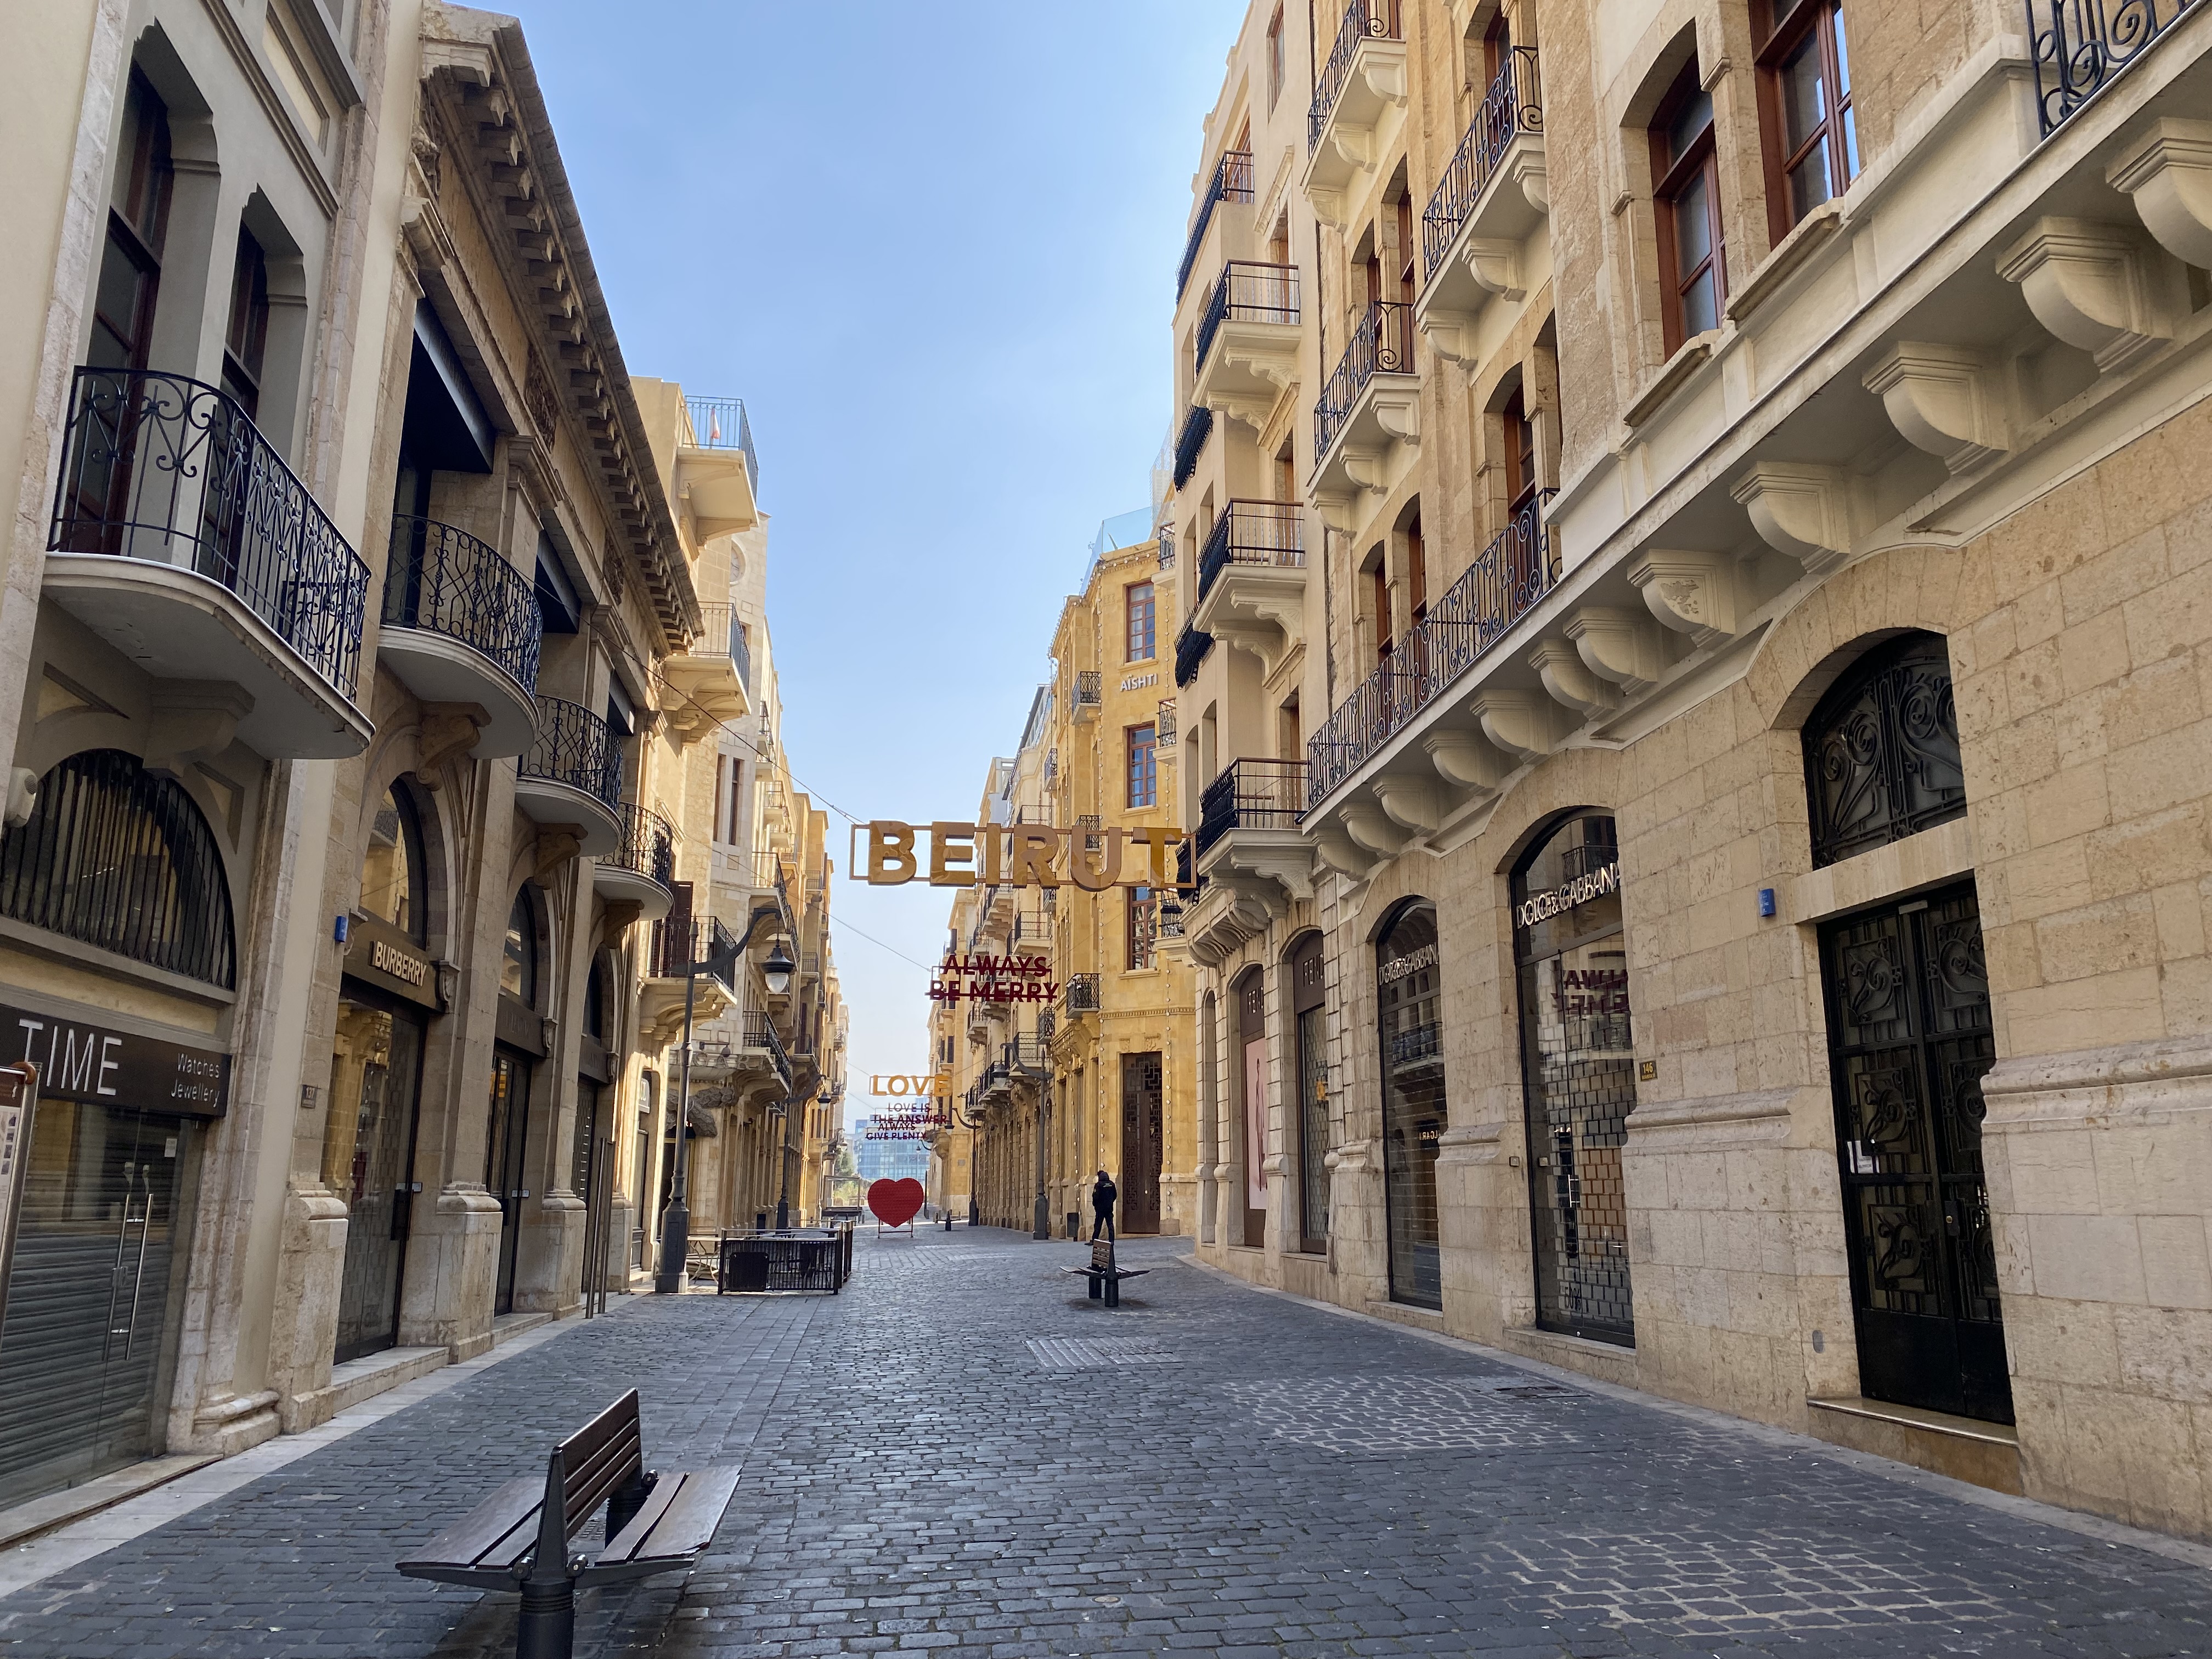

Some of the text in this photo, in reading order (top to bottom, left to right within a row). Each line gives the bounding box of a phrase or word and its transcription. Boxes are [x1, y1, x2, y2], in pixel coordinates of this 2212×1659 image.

[1120, 673, 1158, 692] AÏSHTI
[867, 820, 1182, 891] BEIRUT
[370, 941, 427, 987] BURBERRY
[944, 955, 1047, 977] ALWAYS
[1303, 953, 1324, 987] FEND
[1379, 942, 1439, 985] DOLCE&GABBAN
[930, 980, 1060, 1003] BE MERRY
[1248, 986, 1263, 1014] FEND
[19, 1018, 122, 1096] TIME
[178, 1053, 219, 1078] Watches
[1643, 1062, 1654, 1074] 146
[171, 1078, 219, 1108] Jewellery
[873, 1074, 950, 1097] LOVE
[873, 1114, 947, 1124] THE ANSWER
[888, 1103, 930, 1112] LOVE IS
[878, 1122, 916, 1131] ALWAYS
[891, 1132, 927, 1140] PLENTY
